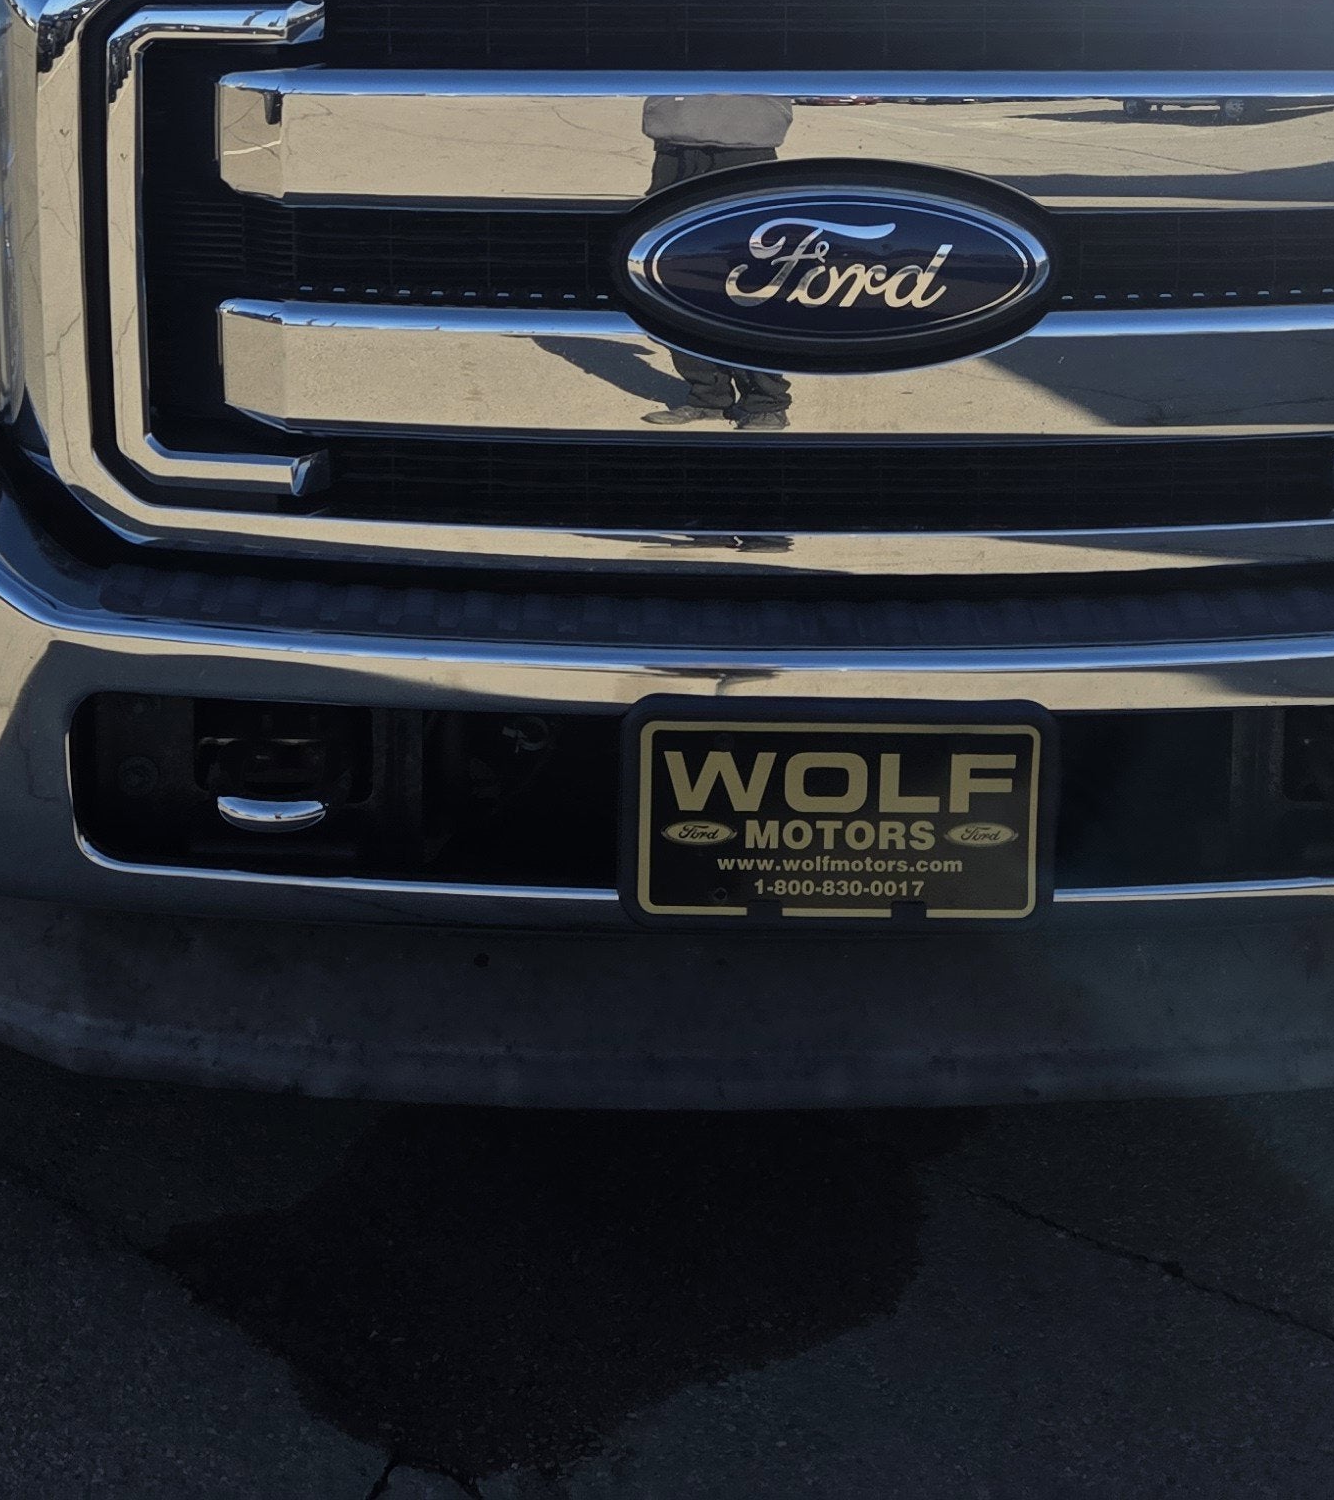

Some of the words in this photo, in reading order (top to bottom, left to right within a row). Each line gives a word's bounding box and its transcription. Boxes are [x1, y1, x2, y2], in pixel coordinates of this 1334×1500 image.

[725, 217, 954, 308] Ford
[664, 750, 1017, 814] WOLF
[677, 825, 720, 841] Ford
[744, 819, 936, 850] MOTORS
[960, 825, 1002, 842] Ford
[717, 856, 963, 873] www.wolfmotors.com
[754, 879, 925, 896] 1-800-830-0017
